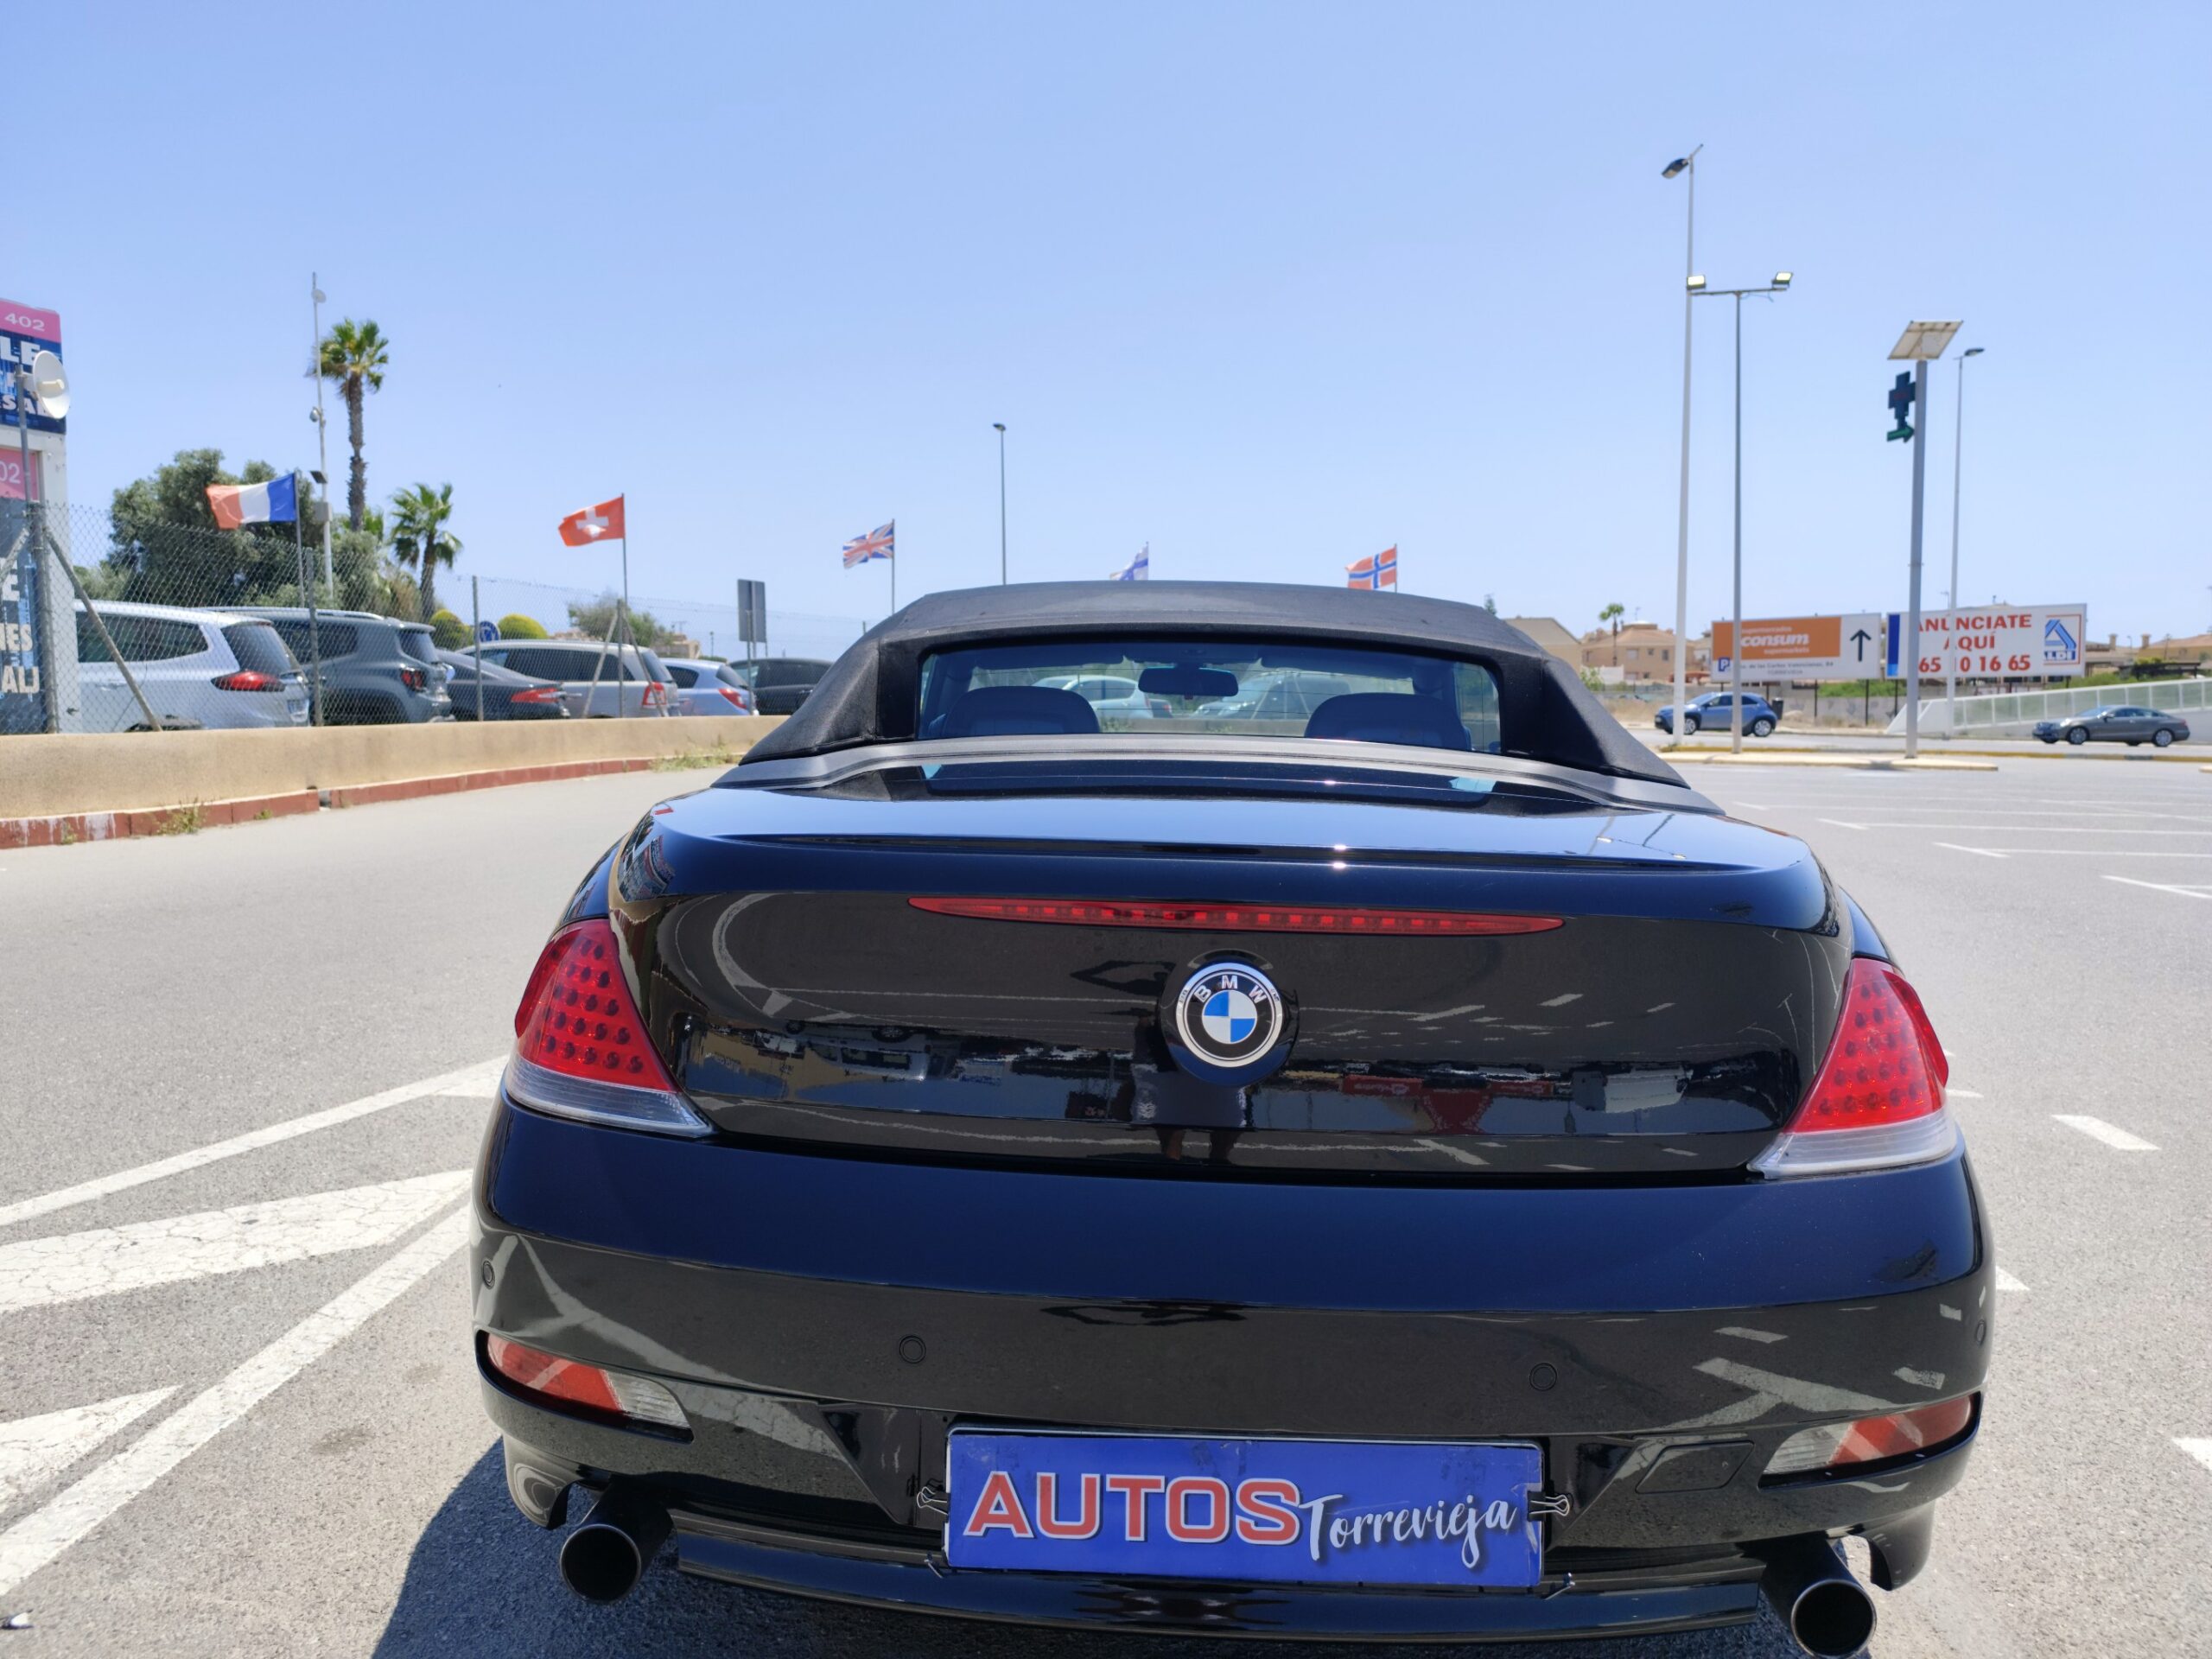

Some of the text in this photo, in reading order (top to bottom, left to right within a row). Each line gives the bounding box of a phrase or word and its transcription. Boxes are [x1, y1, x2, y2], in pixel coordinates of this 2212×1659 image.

[4, 313, 45, 332] 402
[1740, 633, 1810, 648] consum
[1979, 654, 2001, 672] 16
[2007, 654, 2031, 671] 65
[1193, 975, 1268, 1003] BMW
[963, 1471, 1517, 1567] AUTOS Torrevieja
